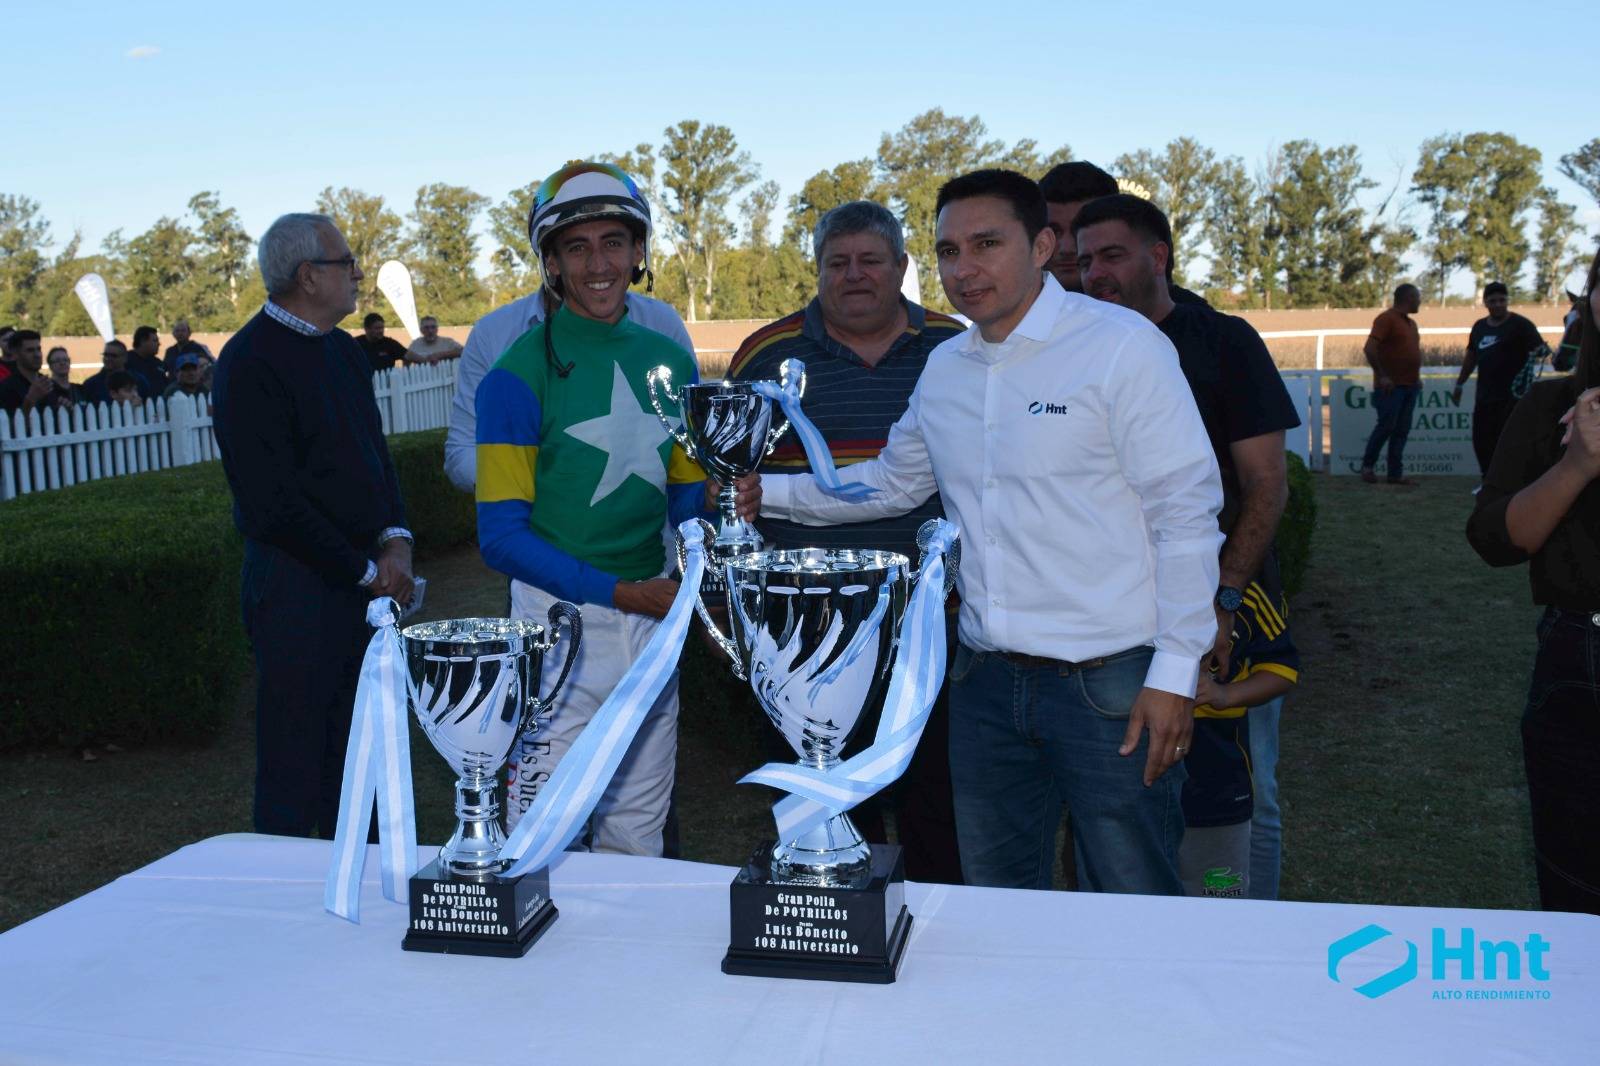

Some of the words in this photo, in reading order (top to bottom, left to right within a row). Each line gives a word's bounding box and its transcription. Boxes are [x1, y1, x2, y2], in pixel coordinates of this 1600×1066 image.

[1046, 403, 1067, 414] Hnt
[521, 738, 551, 765] Es
[433, 882, 457, 894] Gran
[1203, 888, 1244, 898] LACOSTE
[422, 893, 436, 905] De
[439, 895, 498, 908] POTRILLOS
[777, 893, 803, 905] Gran
[451, 908, 498, 922] Bonetto
[765, 905, 780, 916] De
[783, 906, 848, 921] POTRILLOS
[413, 919, 434, 931] 108
[437, 921, 509, 936] Aniversario
[796, 925, 848, 940] Bonetto
[754, 936, 777, 949] 108
[781, 938, 859, 955] Aniversario
